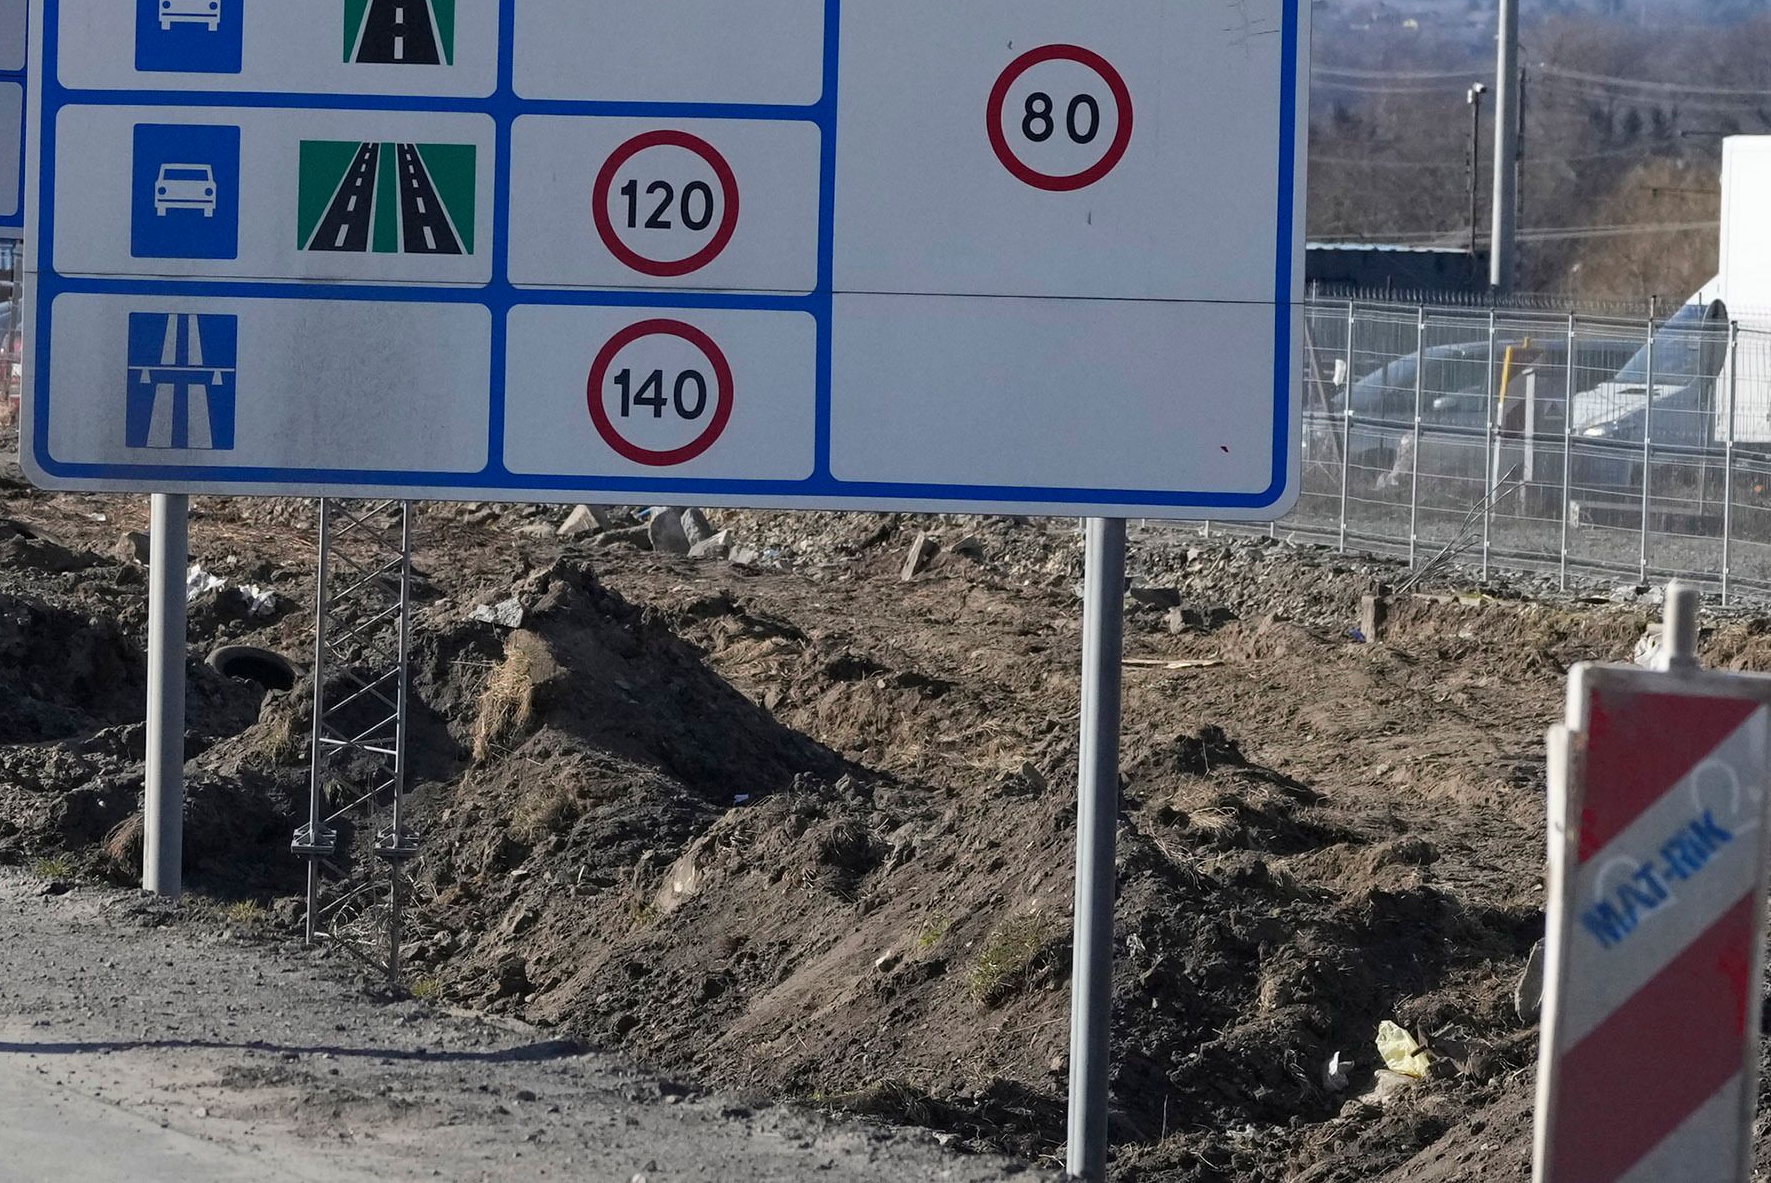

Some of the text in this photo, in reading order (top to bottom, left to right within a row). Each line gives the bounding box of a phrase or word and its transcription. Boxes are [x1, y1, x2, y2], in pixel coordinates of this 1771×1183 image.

[1020, 91, 1102, 145] 80
[620, 178, 714, 232] 120
[612, 367, 708, 421] 140
